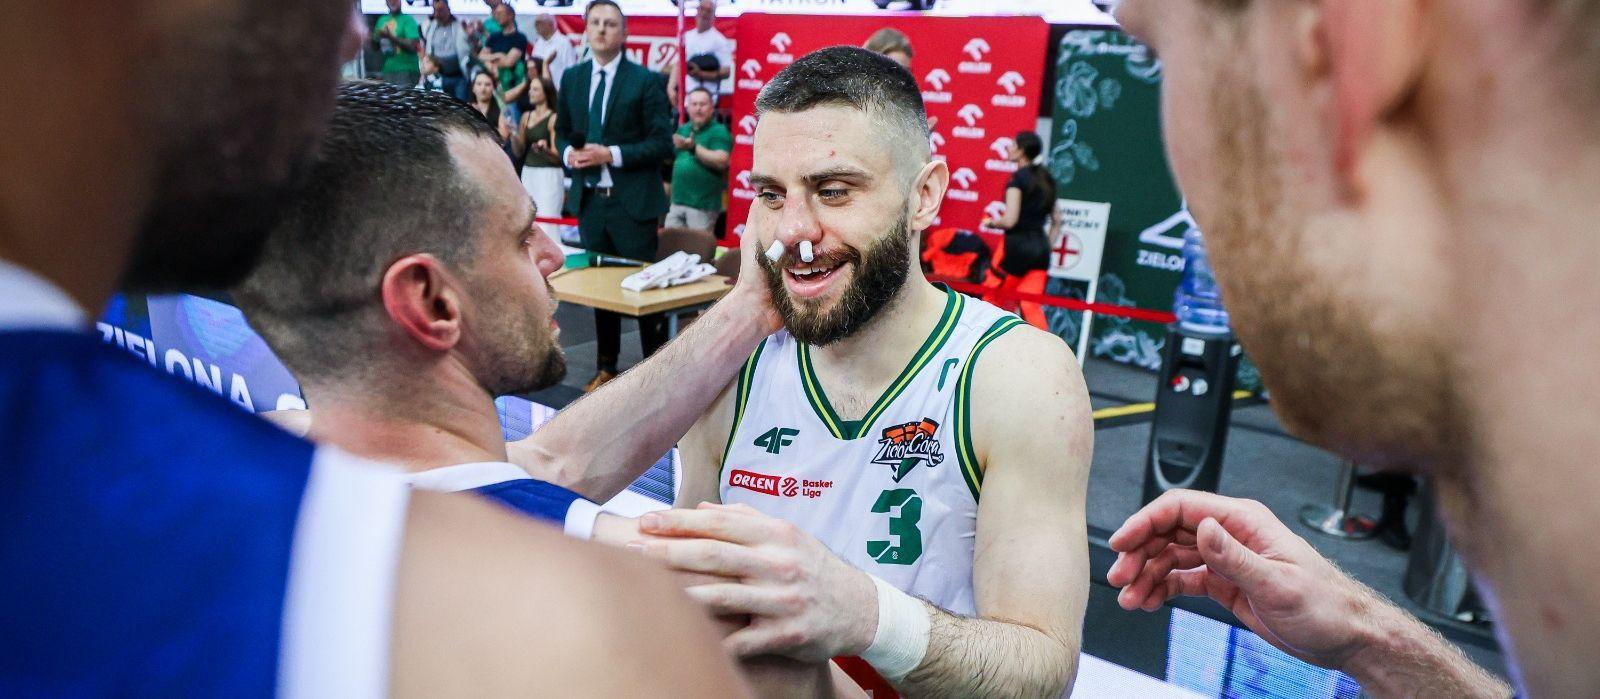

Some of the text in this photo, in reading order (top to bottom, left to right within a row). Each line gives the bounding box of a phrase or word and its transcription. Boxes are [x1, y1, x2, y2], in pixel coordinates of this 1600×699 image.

[1136, 249, 1186, 272] ZIELO
[753, 426, 800, 454] 4F
[732, 473, 775, 491] ORLEN
[802, 479, 834, 488] Basket
[802, 488, 822, 498] Liga
[866, 488, 923, 566] 3
